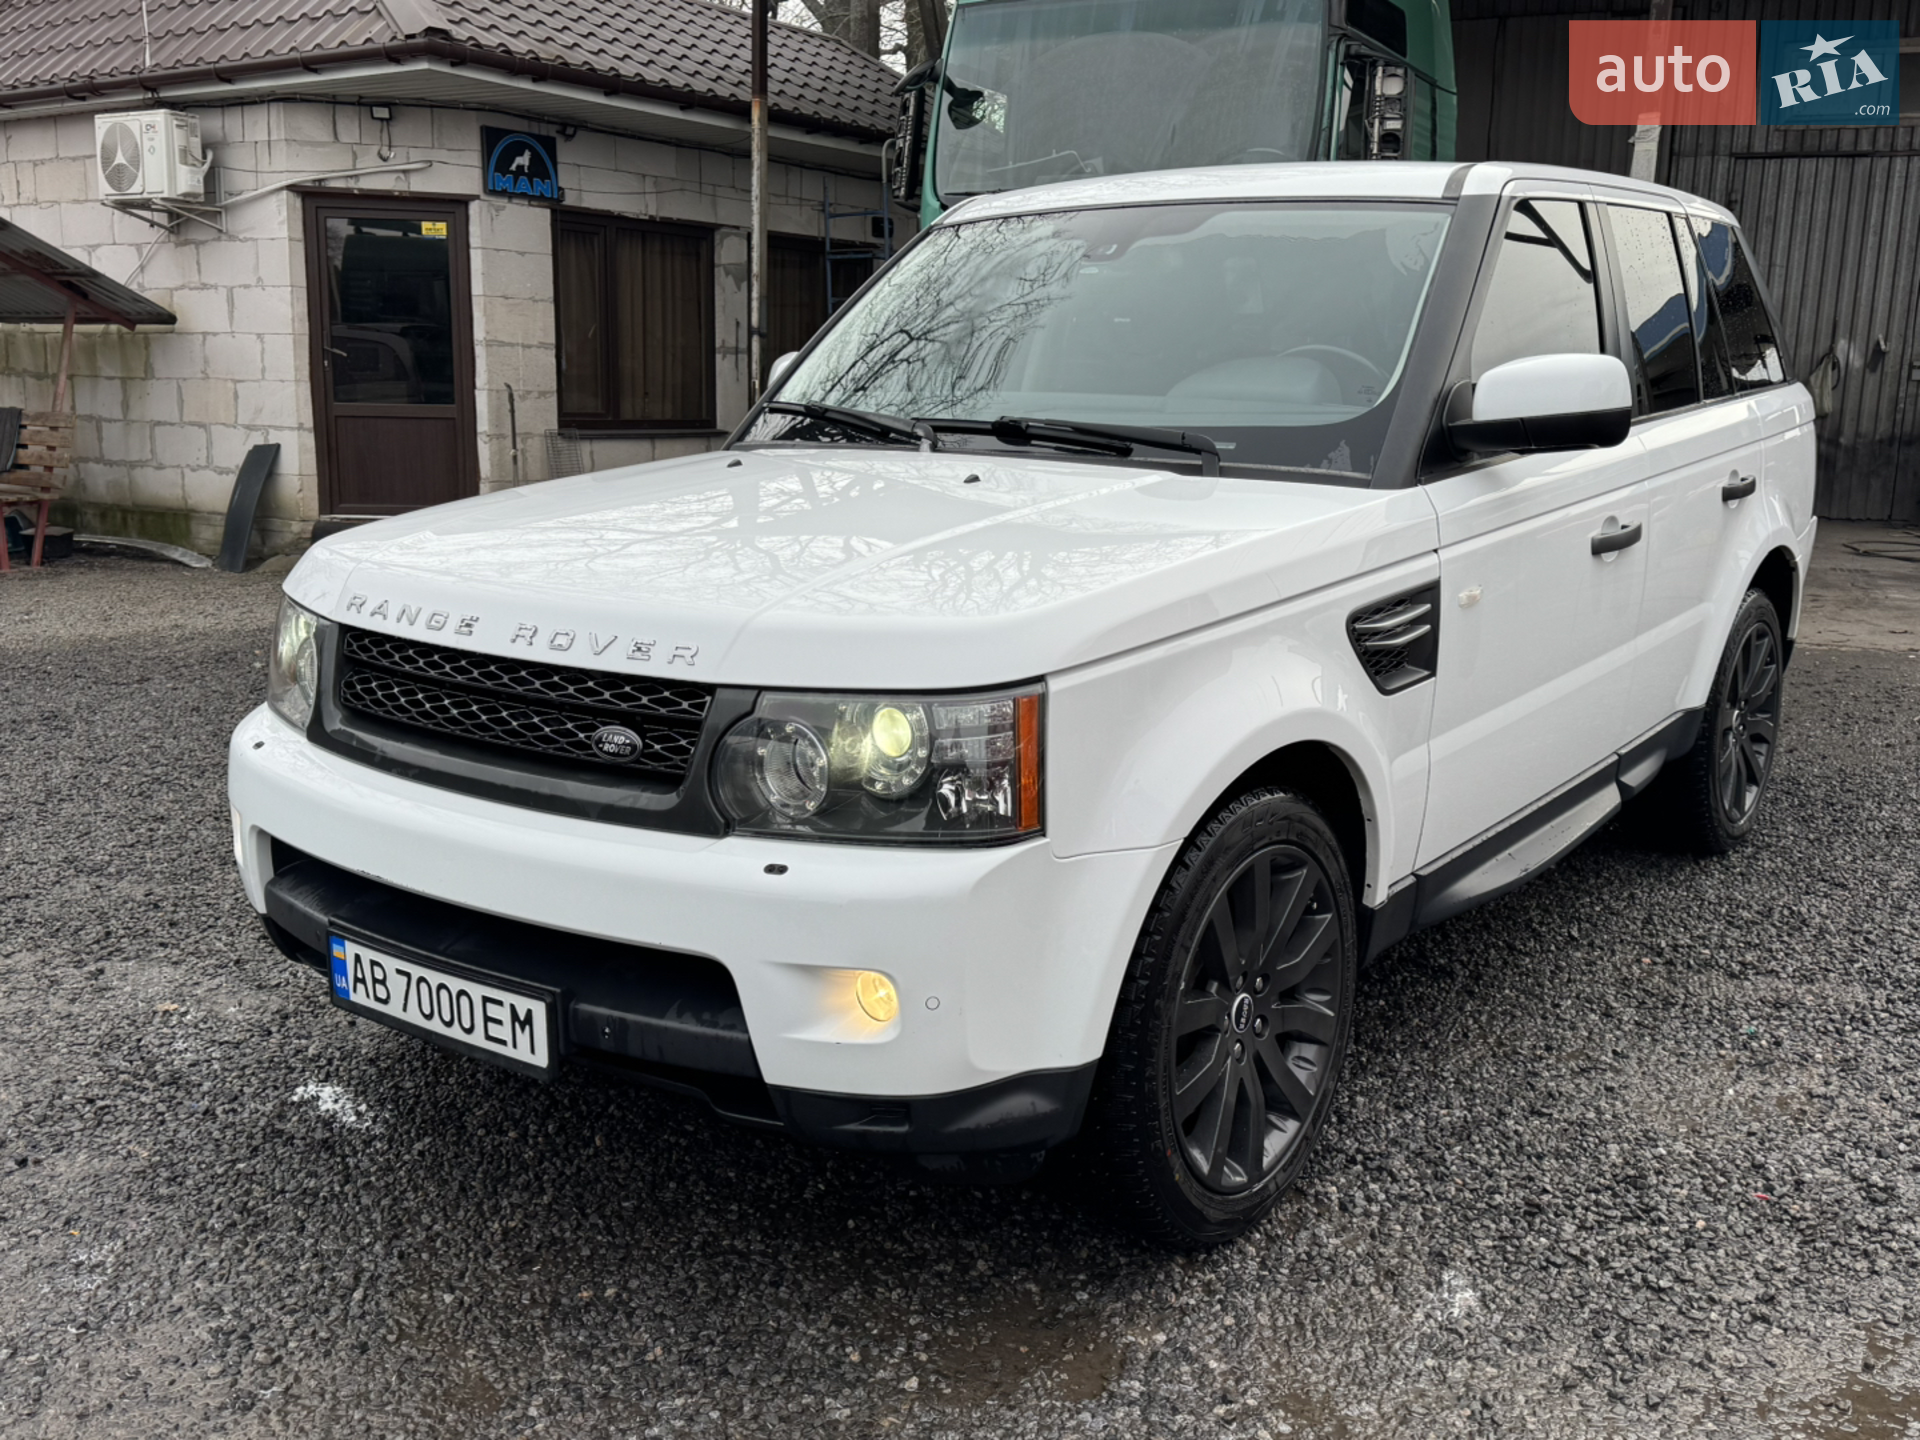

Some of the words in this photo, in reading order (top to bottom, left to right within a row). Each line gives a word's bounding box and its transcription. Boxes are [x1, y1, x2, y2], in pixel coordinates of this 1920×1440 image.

[494, 172, 551, 198] MAN
[346, 593, 479, 636] RANGE
[510, 622, 699, 666] ROVER
[335, 973, 348, 990] UA
